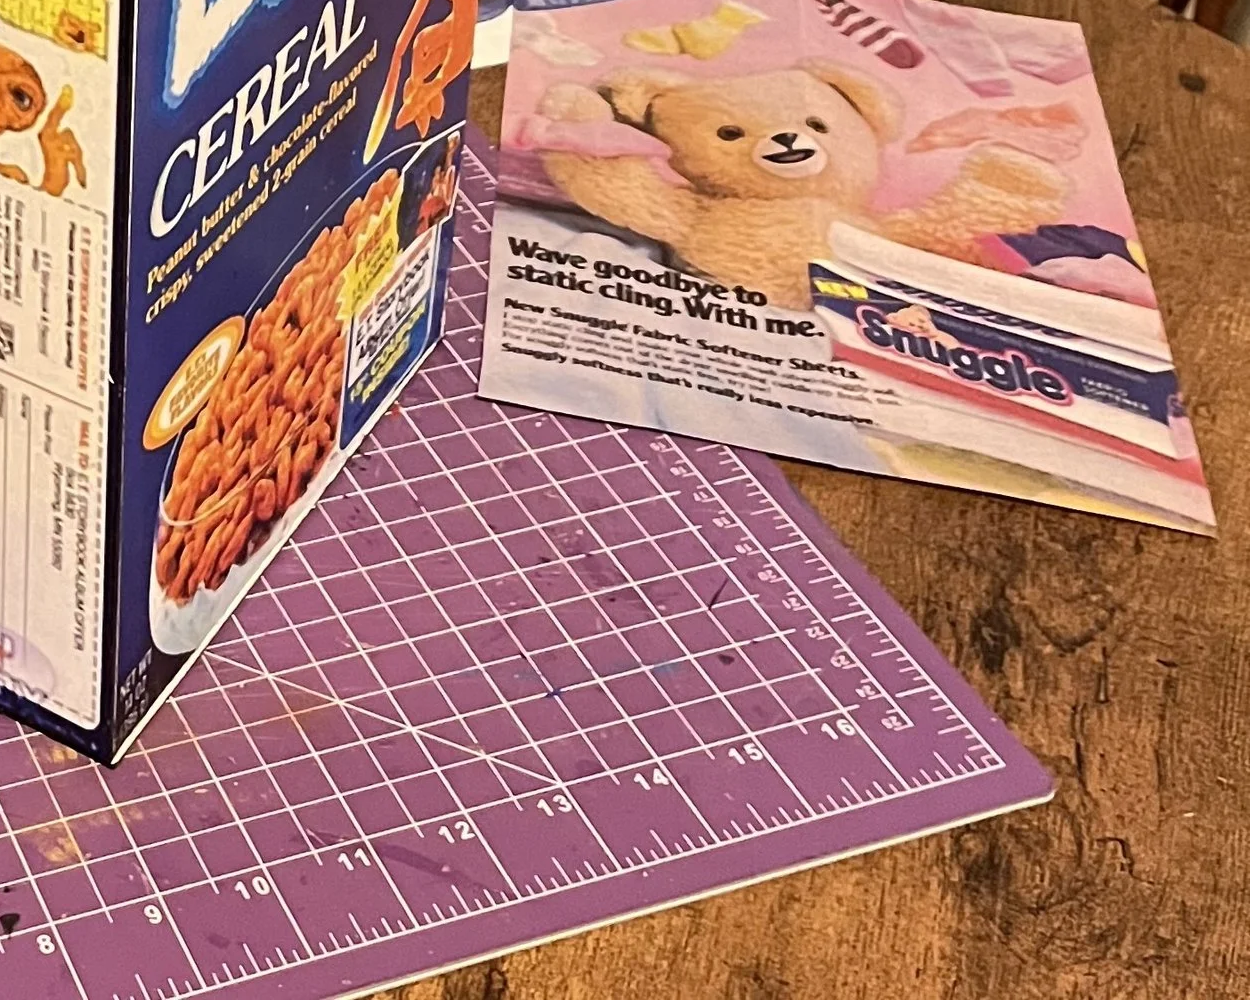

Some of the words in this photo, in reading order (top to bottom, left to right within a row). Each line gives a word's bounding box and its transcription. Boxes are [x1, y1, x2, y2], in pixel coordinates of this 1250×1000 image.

[146, 223, 197, 297] Peanut
[201, 176, 243, 240] butter
[247, 159, 259, 192] &
[263, 36, 377, 175] chocolate-flavored
[145, 256, 193, 332] crispy,
[196, 177, 268, 275] sweetened
[271, 127, 317, 199] 2-grain
[319, 85, 356, 143] cereal
[507, 236, 588, 269] Wave
[593, 259, 732, 300] goodbye
[732, 285, 767, 307] to
[507, 263, 594, 294] static
[599, 280, 680, 317] cling.
[683, 296, 757, 330] With
[765, 315, 825, 338] me.
[504, 298, 545, 314] New
[550, 306, 628, 331] Snuggle
[633, 324, 692, 347] Fabric
[696, 338, 783, 367] Softener
[501, 342, 567, 364] Snuggly
[572, 358, 643, 378] softness
[862, 310, 1066, 400] Snuggle
[53, 515, 63, 537] MN
[75, 494, 89, 569] STORYBOOK
[74, 567, 85, 611] ALBUM
[73, 610, 84, 652] OFFER
[820, 718, 857, 741] 16
[728, 742, 764, 765] 15
[633, 768, 671, 791] 14
[537, 794, 574, 818] 13
[439, 820, 476, 846] 12
[337, 848, 373, 872] 11
[234, 876, 271, 901] 10
[144, 904, 163, 926] 9
[36, 934, 56, 955] 8
